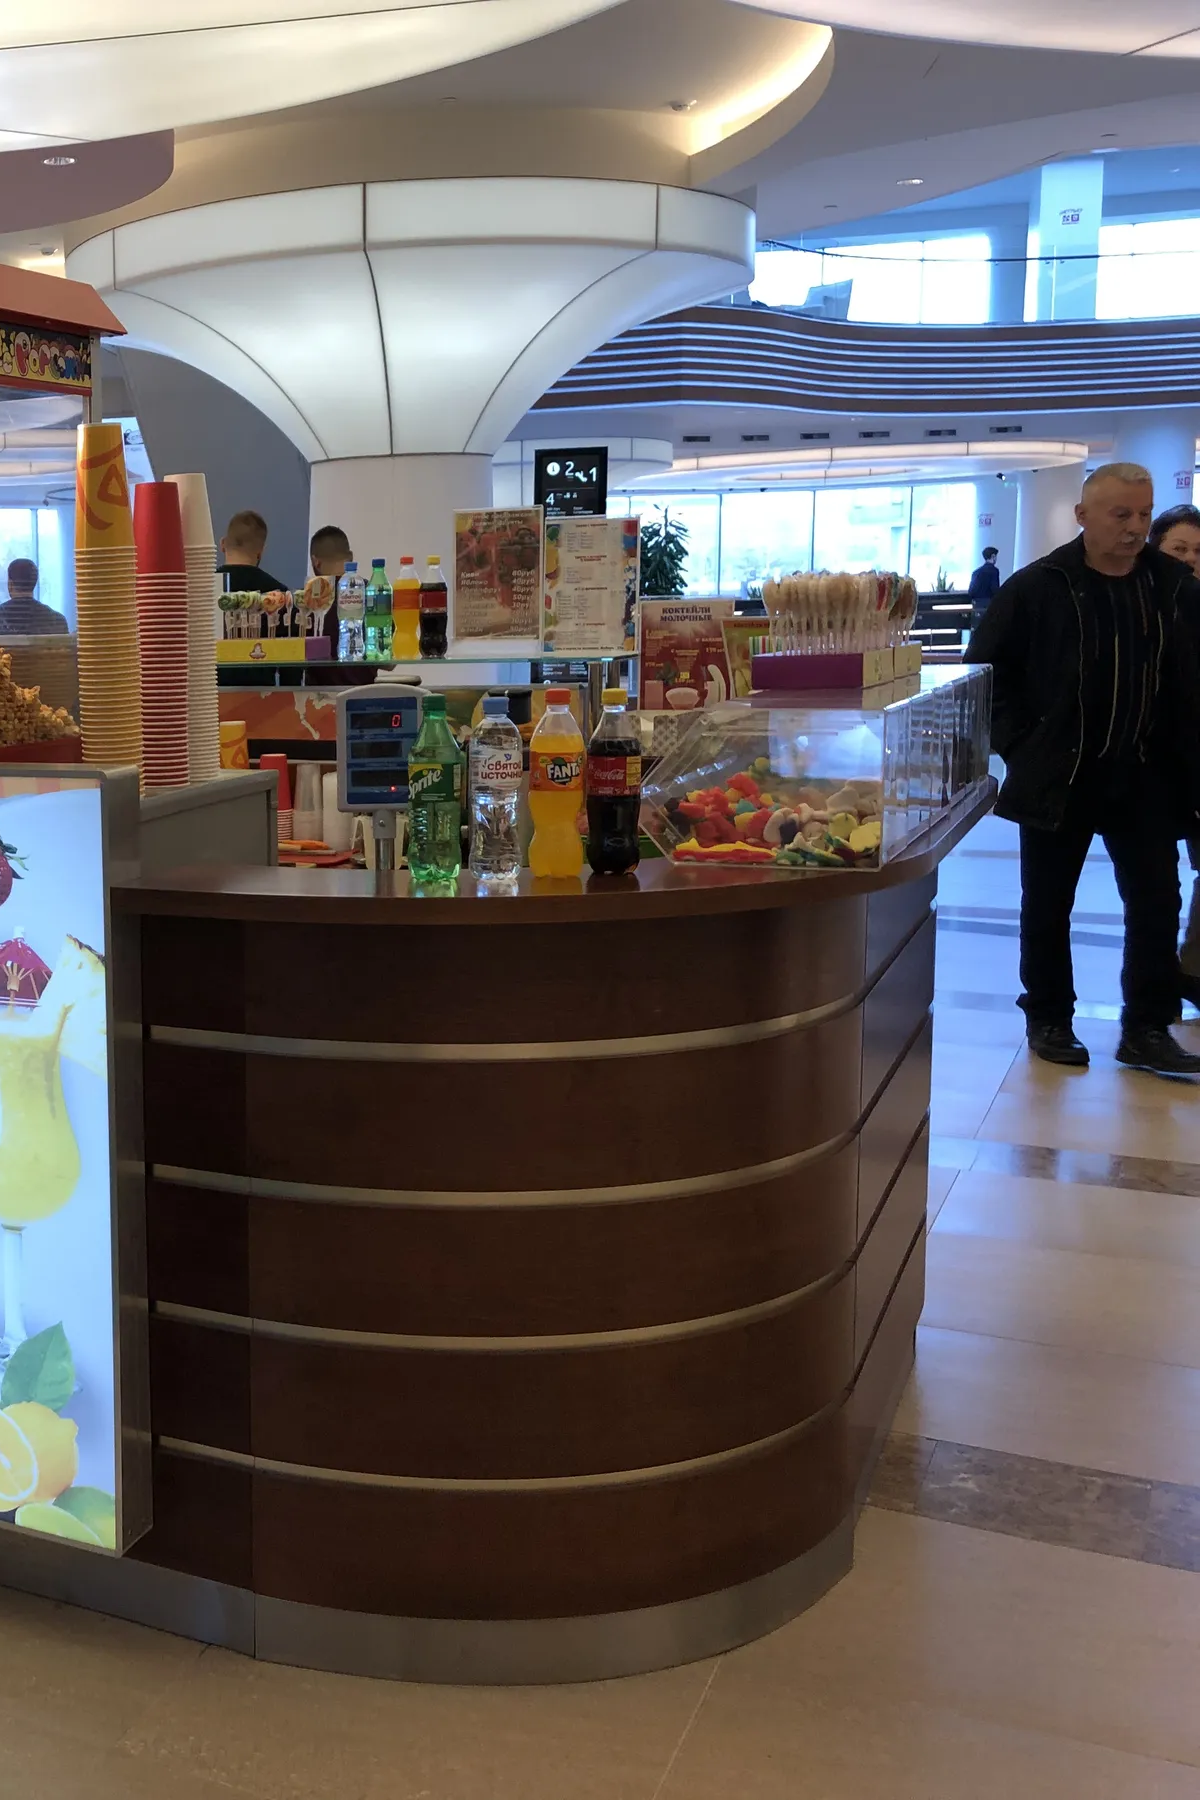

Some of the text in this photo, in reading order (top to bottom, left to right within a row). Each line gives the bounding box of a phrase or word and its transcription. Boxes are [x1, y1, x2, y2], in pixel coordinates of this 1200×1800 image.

[565, 461, 574, 476] 2
[546, 493, 555, 505] 4
[662, 605, 711, 614] КОКТЕЙЛИ
[660, 614, 712, 622] МОЛОЧНЫЕ
[392, 714, 401, 728] 0
[546, 762, 581, 780] FANTA
[408, 769, 442, 800] Sprite
